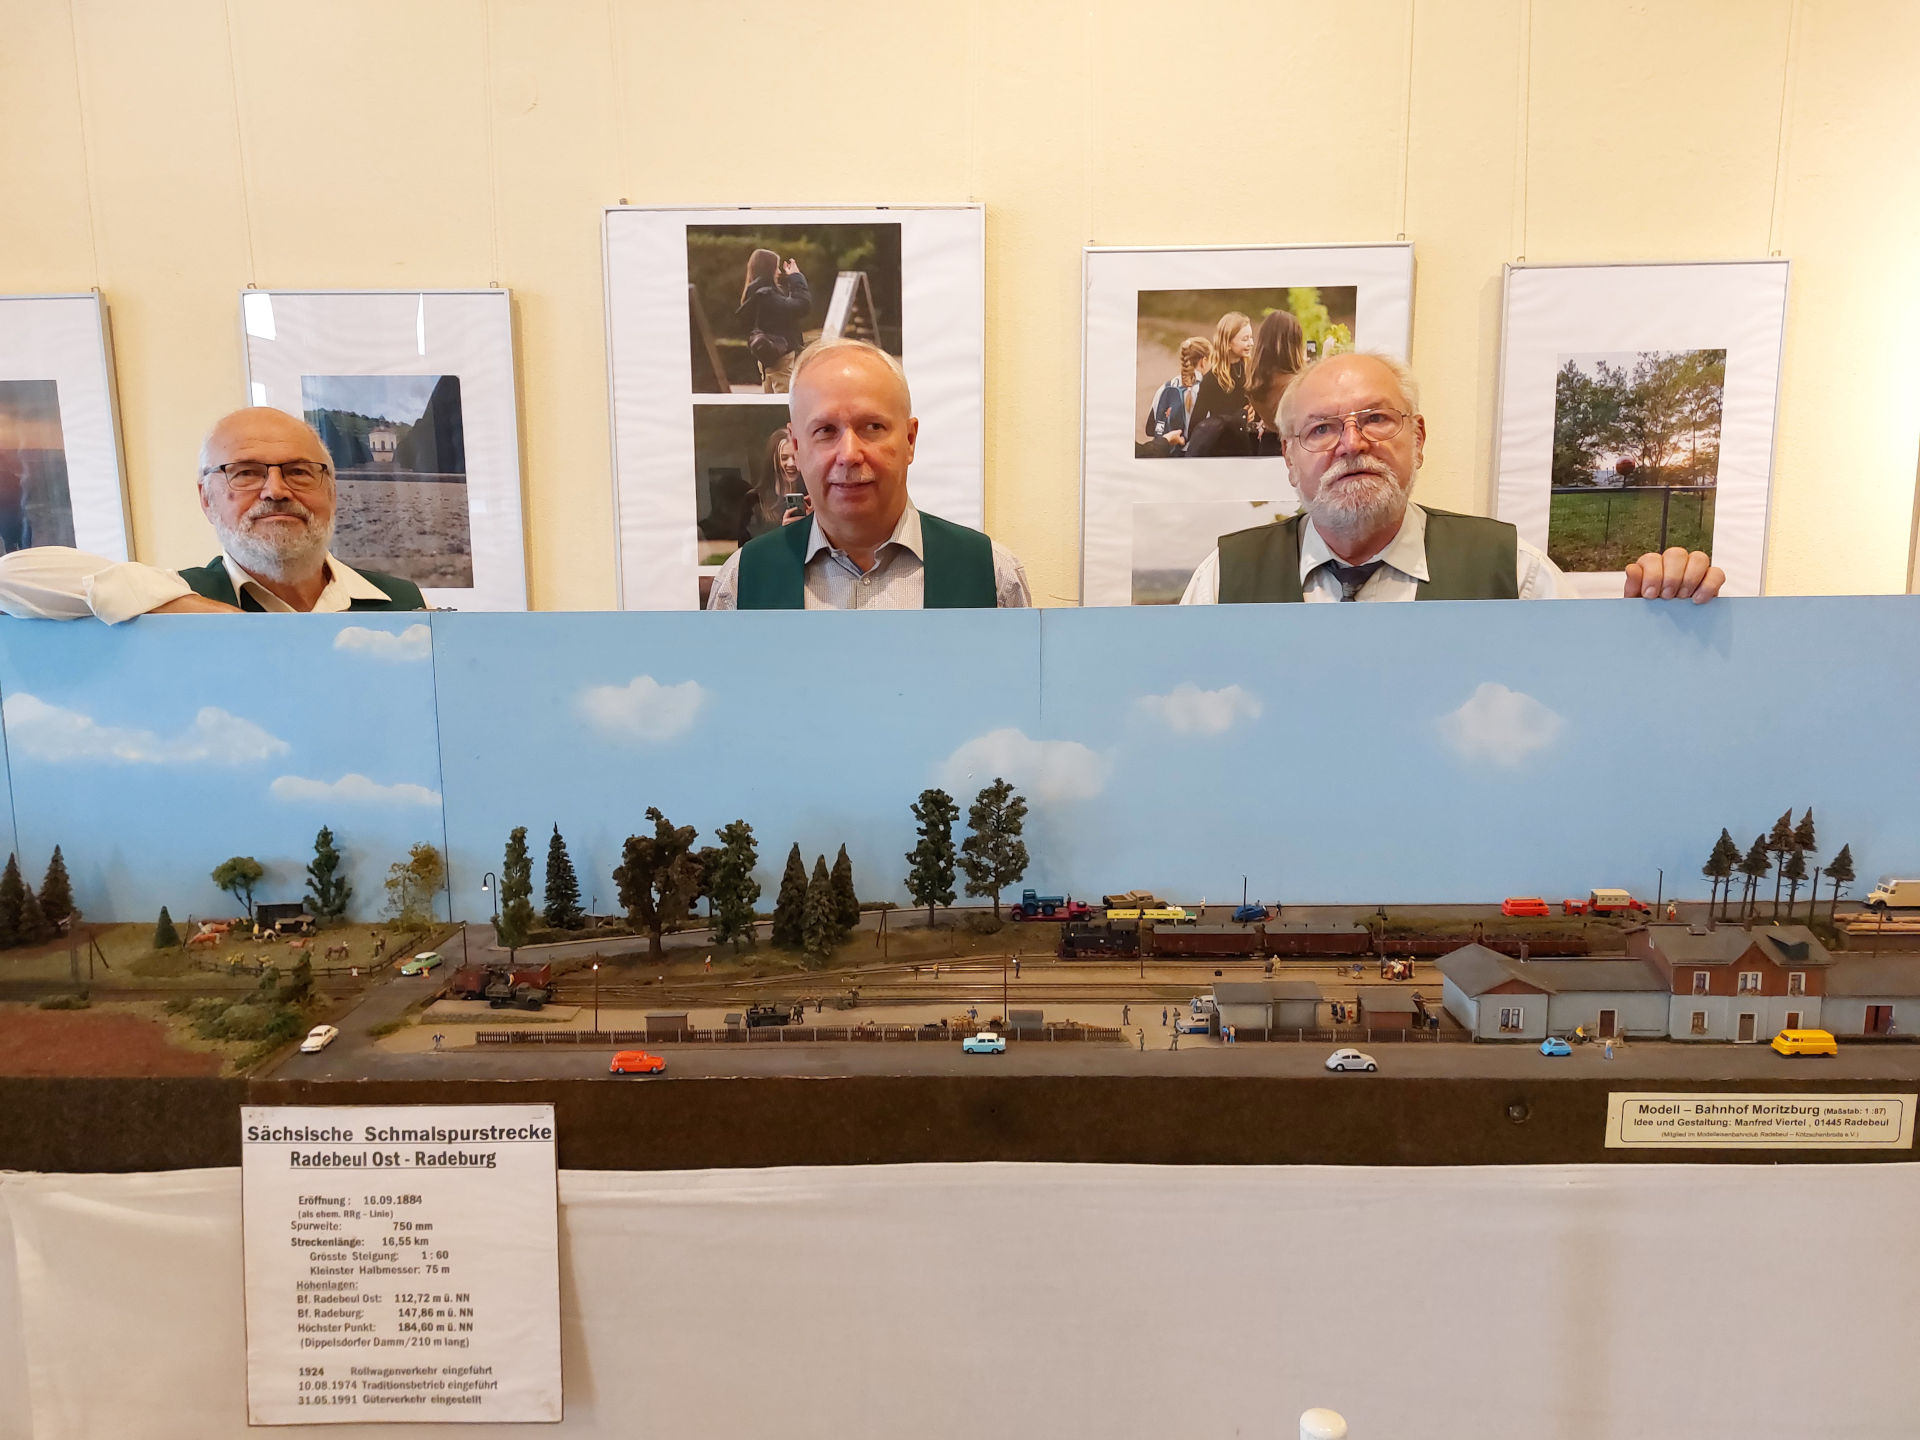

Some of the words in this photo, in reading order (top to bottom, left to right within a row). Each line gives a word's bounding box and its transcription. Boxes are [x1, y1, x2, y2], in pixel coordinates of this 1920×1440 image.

[1638, 1104, 1680, 1115] Modell
[1695, 1104, 1749, 1115] Bahnhof
[1752, 1104, 1820, 1117] Moritzburg
[1633, 1118, 1654, 1127] Idee
[1656, 1118, 1675, 1127] und
[1677, 1118, 1732, 1128] Gestaltung:
[1734, 1118, 1773, 1127] Manfred
[1814, 1118, 1842, 1127] 01445
[1844, 1118, 1889, 1127] Radebeul
[247, 1125, 354, 1142] Sächsische
[364, 1123, 553, 1144] Schmalspurstrecke
[290, 1151, 367, 1168] Radebeul
[372, 1151, 400, 1167] Ost
[415, 1151, 497, 1169] Radeburg
[363, 1194, 423, 1206] 16.09.1884
[297, 1209, 314, 1219] (als
[369, 1209, 394, 1219] Linie)
[291, 1220, 342, 1232] Spurweite:
[393, 1221, 413, 1231] 750
[415, 1222, 433, 1231] mm
[290, 1237, 365, 1248] Streckenlänge:
[382, 1236, 412, 1247] 16,55
[414, 1237, 429, 1246] km
[352, 1251, 399, 1262] Steigung:
[310, 1265, 354, 1275] Kleinster
[426, 1264, 439, 1274] 75
[441, 1265, 450, 1274] m
[297, 1294, 311, 1304] Bf.
[313, 1293, 360, 1304] Radebeul
[394, 1293, 431, 1304] 112,72
[432, 1294, 442, 1302] m
[455, 1292, 471, 1302] NN
[297, 1308, 312, 1318] Bf.
[398, 1307, 434, 1318] 147,86
[436, 1308, 445, 1317] m
[459, 1307, 474, 1317] NN
[436, 1323, 445, 1332] m
[459, 1321, 474, 1332] NN
[300, 1337, 371, 1349] (Dippelsdorfer
[433, 1338, 442, 1346] m
[444, 1336, 470, 1348] lang)
[299, 1367, 325, 1377] 1924
[350, 1366, 438, 1378] Rollwagenverkehr
[298, 1380, 358, 1391] 10.08.1974
[362, 1380, 446, 1391] Traditionsbetrieb
[297, 1395, 358, 1405] 31.05.1991
[430, 1394, 482, 1405] eingestellt
